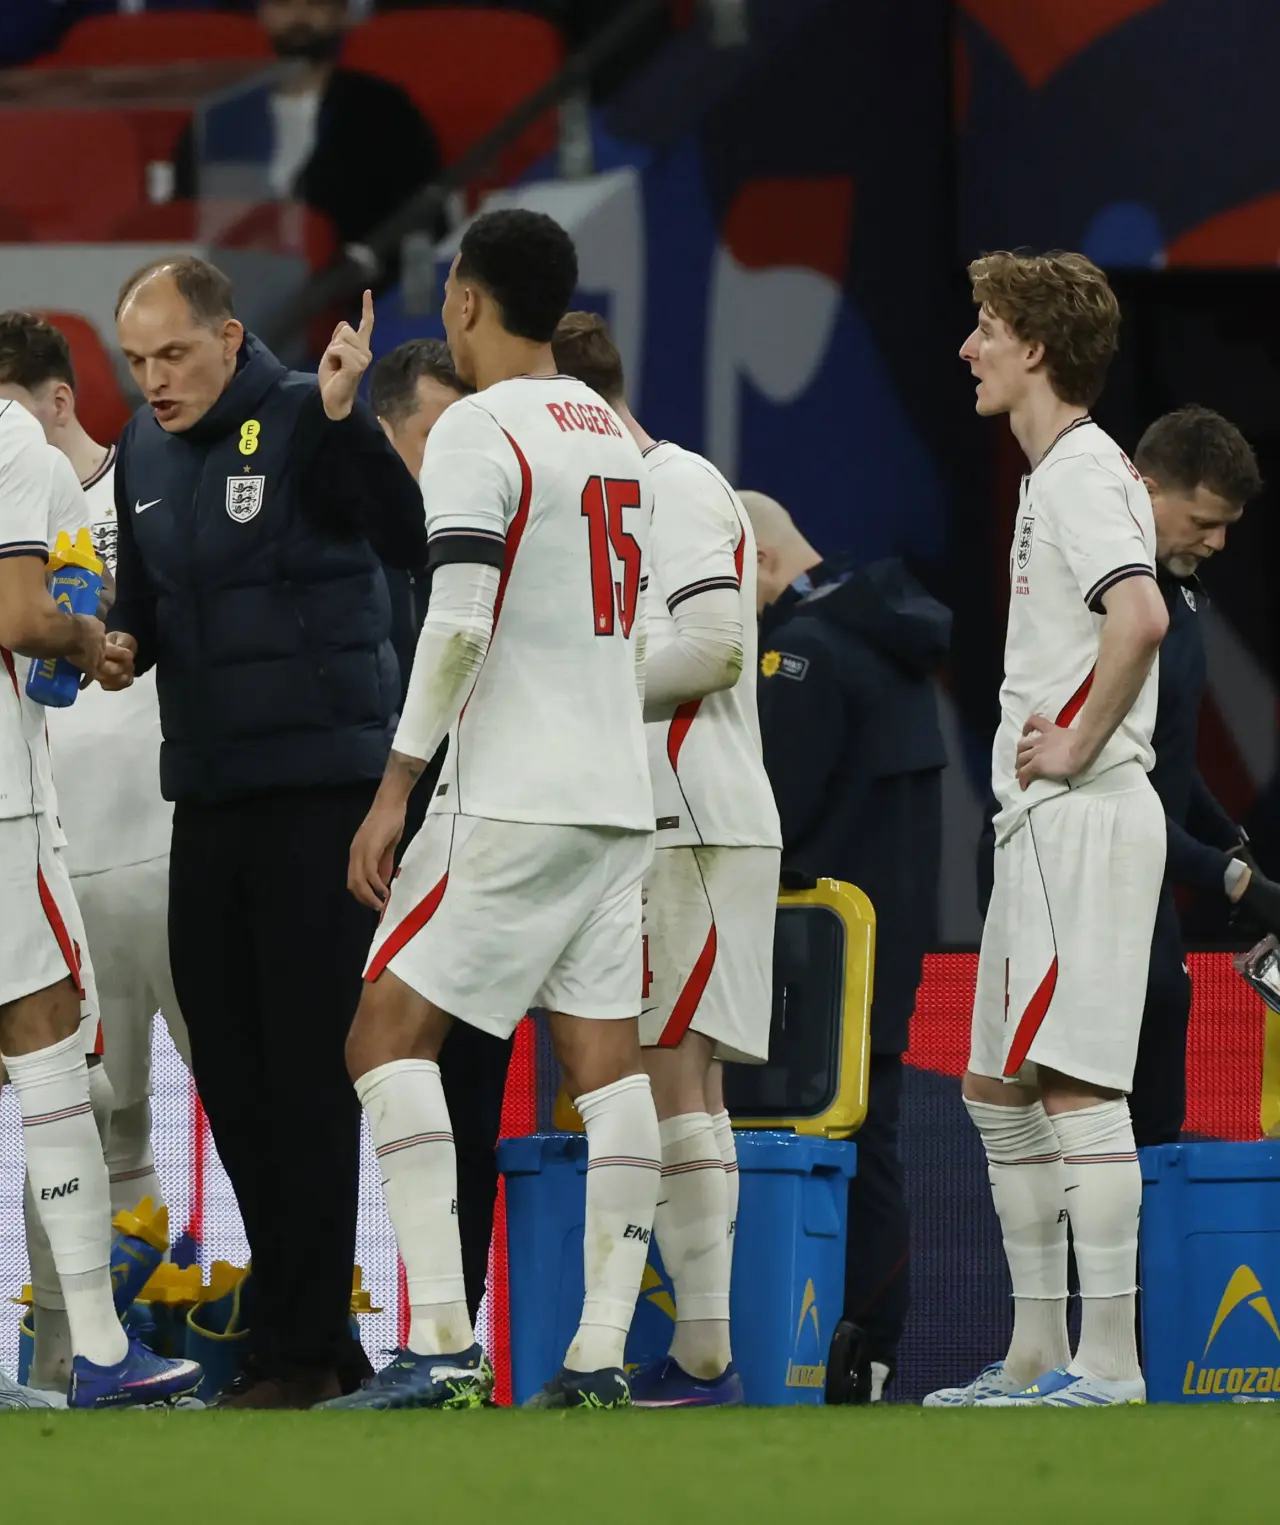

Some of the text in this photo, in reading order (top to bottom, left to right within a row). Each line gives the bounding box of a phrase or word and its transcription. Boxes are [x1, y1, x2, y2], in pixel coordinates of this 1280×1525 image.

[545, 401, 623, 439] ROGERS
[581, 475, 642, 640] 15
[41, 1177, 79, 1200] ENG
[623, 1224, 651, 1244] ENG
